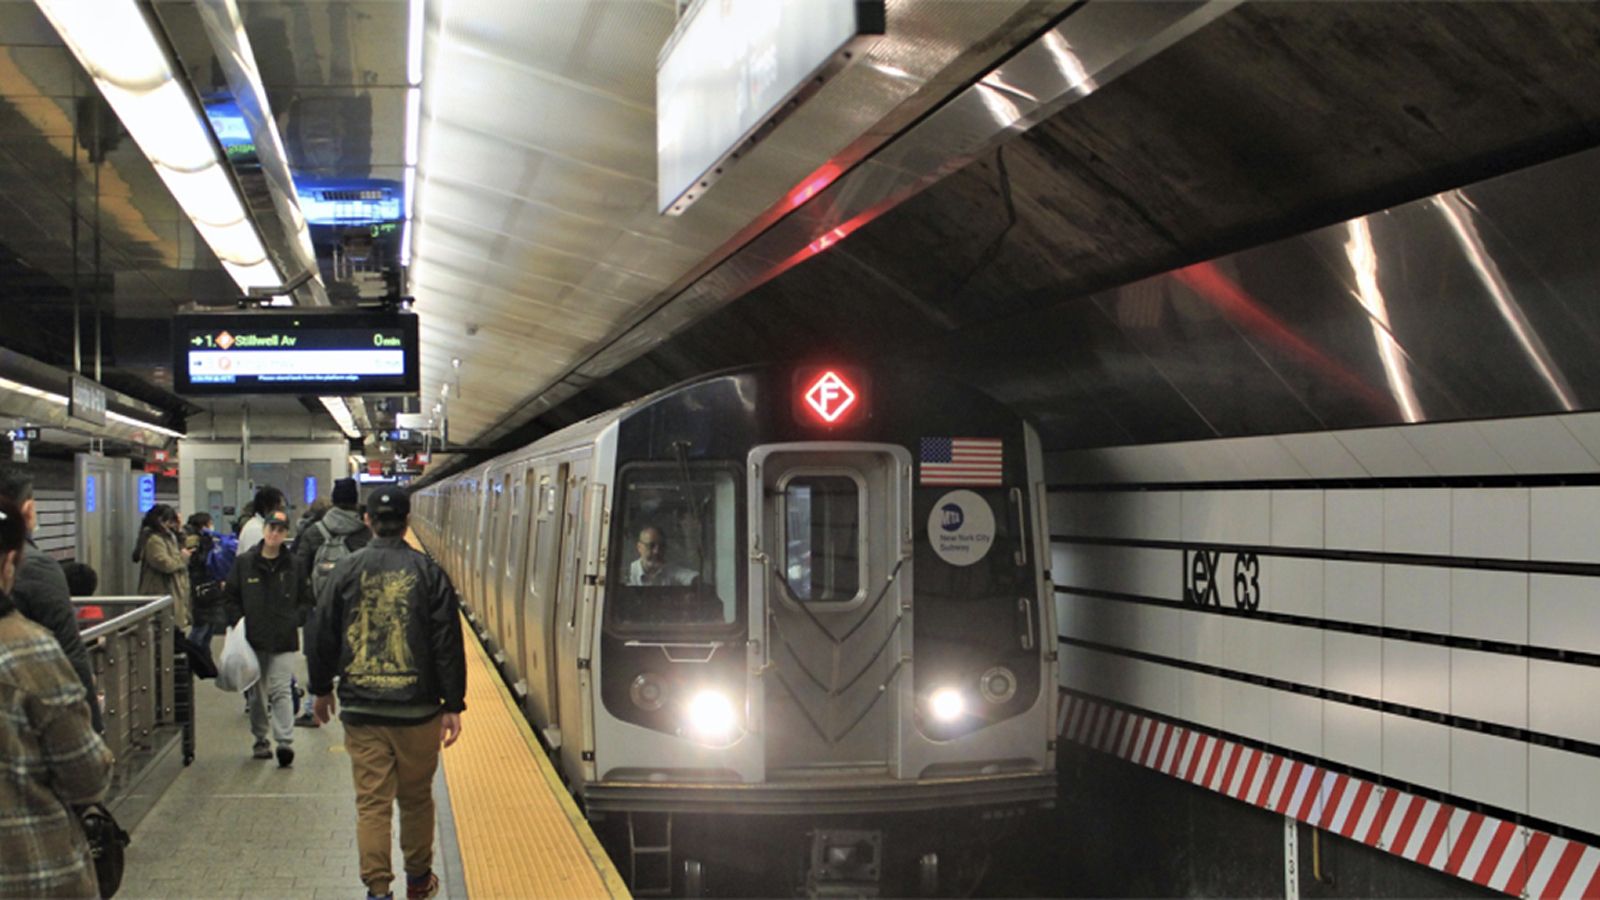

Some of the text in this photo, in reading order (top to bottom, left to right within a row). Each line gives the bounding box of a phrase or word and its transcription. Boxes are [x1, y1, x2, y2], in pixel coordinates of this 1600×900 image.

[235, 334, 279, 347] Stillwell
[281, 334, 297, 347] Av
[819, 382, 841, 413] F
[940, 534, 990, 544] New York City
[940, 544, 970, 553] Subway
[1182, 546, 1260, 612] Lex 63
